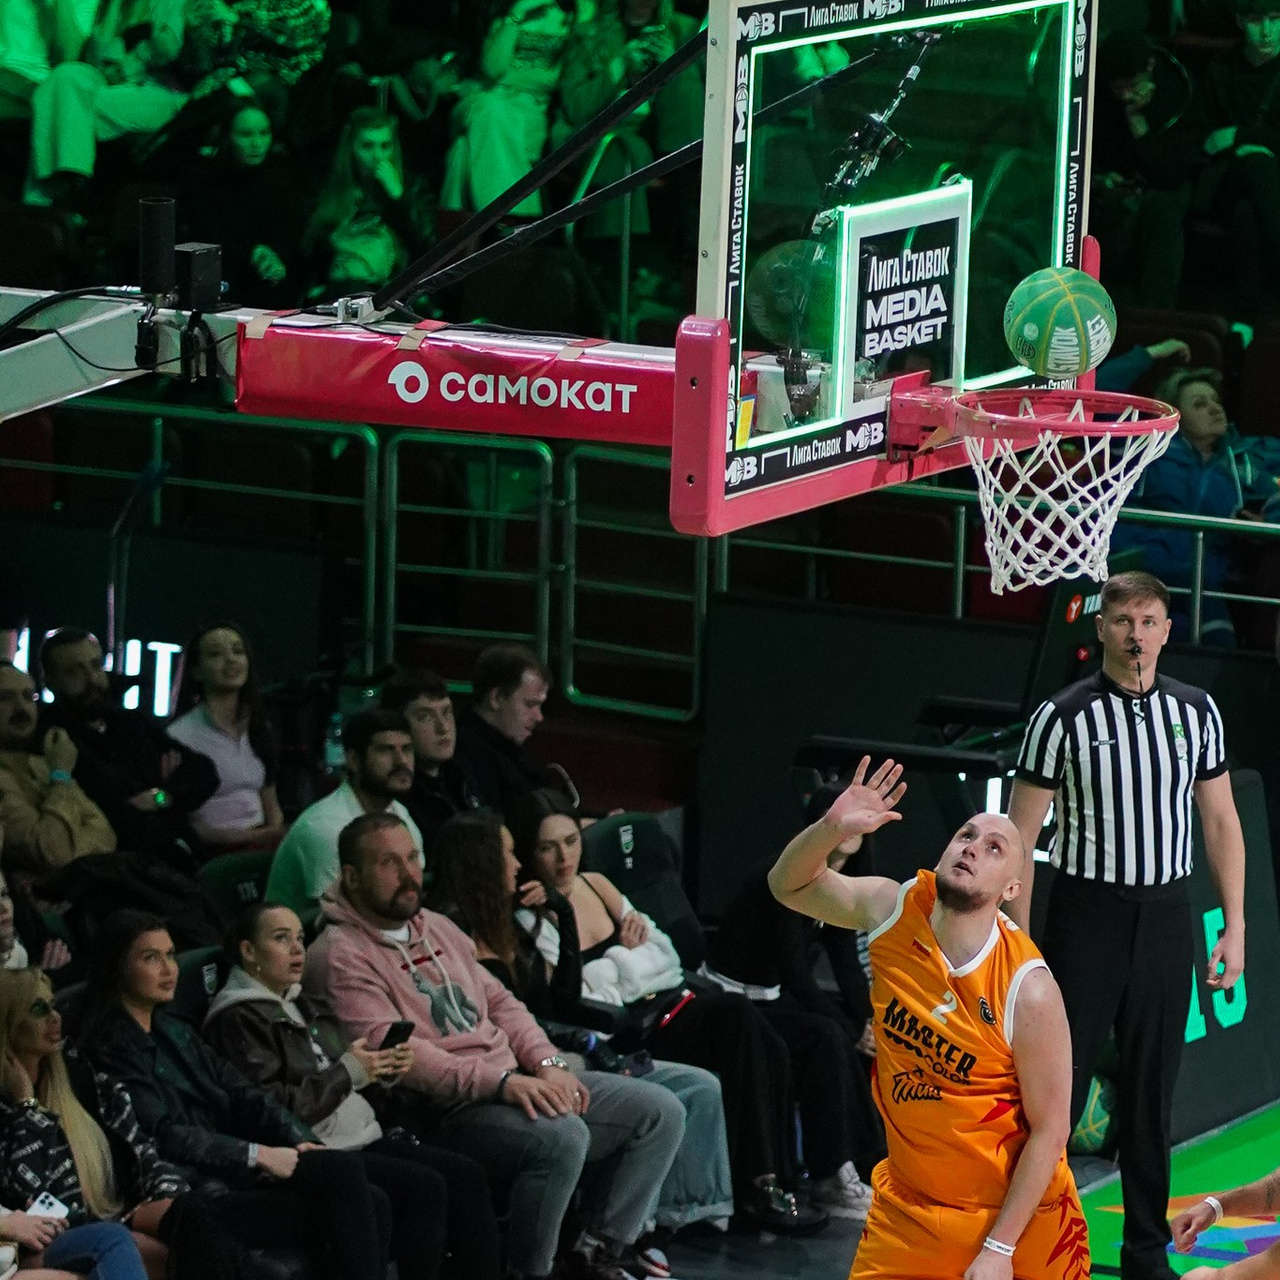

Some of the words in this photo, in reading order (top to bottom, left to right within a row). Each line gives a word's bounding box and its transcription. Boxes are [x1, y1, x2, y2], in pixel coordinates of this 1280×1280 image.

[865, 284, 947, 330] MEDIA
[864, 316, 948, 357] BASKET
[931, 990, 958, 1025] 2
[882, 997, 977, 1078] MASTER
